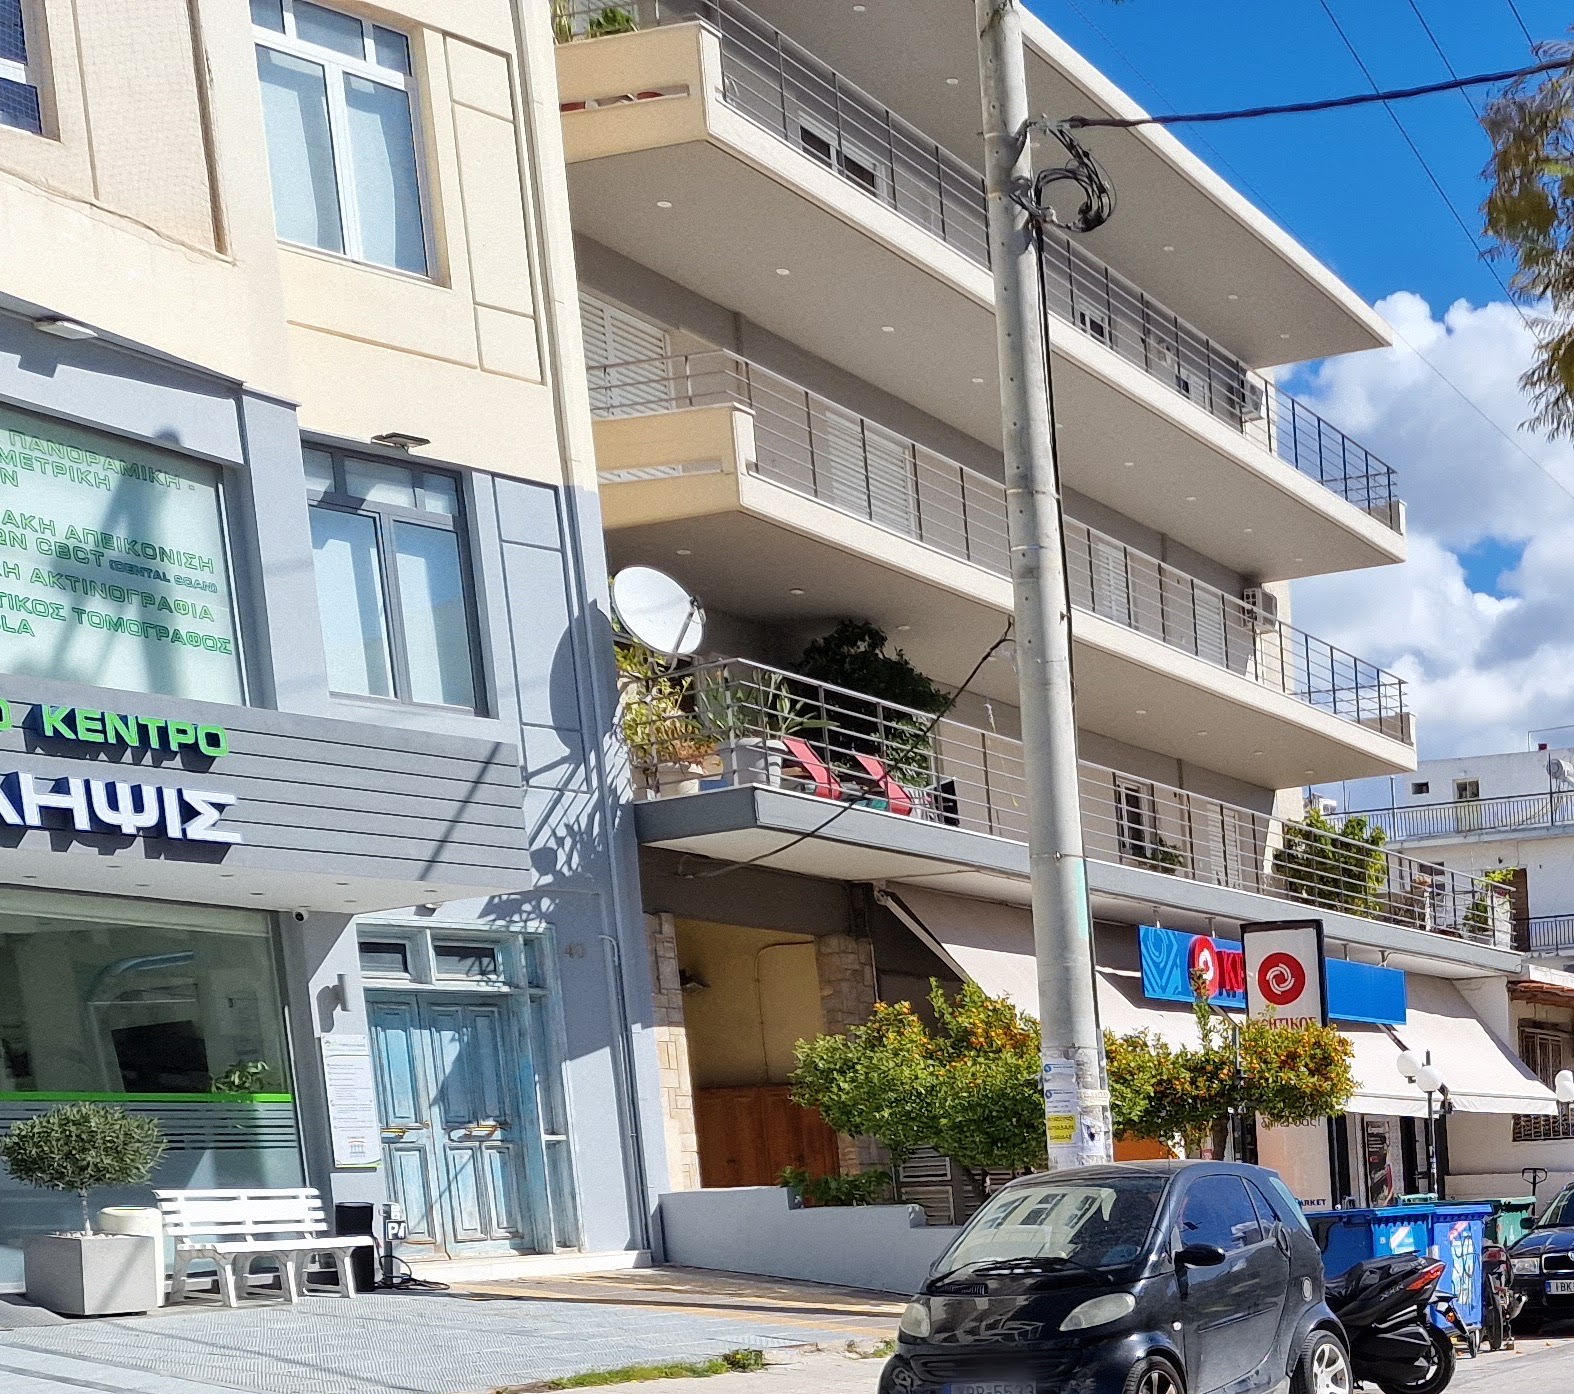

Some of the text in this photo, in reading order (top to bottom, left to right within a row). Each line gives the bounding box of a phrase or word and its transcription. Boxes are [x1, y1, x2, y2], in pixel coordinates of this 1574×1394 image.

[9, 429, 180, 490] ΠΑΝΟΡΑΜΙΚΗ
[36, 537, 104, 567] CBCT
[65, 525, 214, 574] ΑΠΕΙΚΟΝΙΣΗ
[0, 561, 214, 622] Η ΑΚΤΙΝΟΓΡΑΦΙΑ
[72, 606, 233, 654] ΤΟΜΟΓΡΑΦΟΣ
[41, 704, 230, 757] ΚΕΝΤΡΟ
[1295, 1198, 1327, 1207] ARKET
